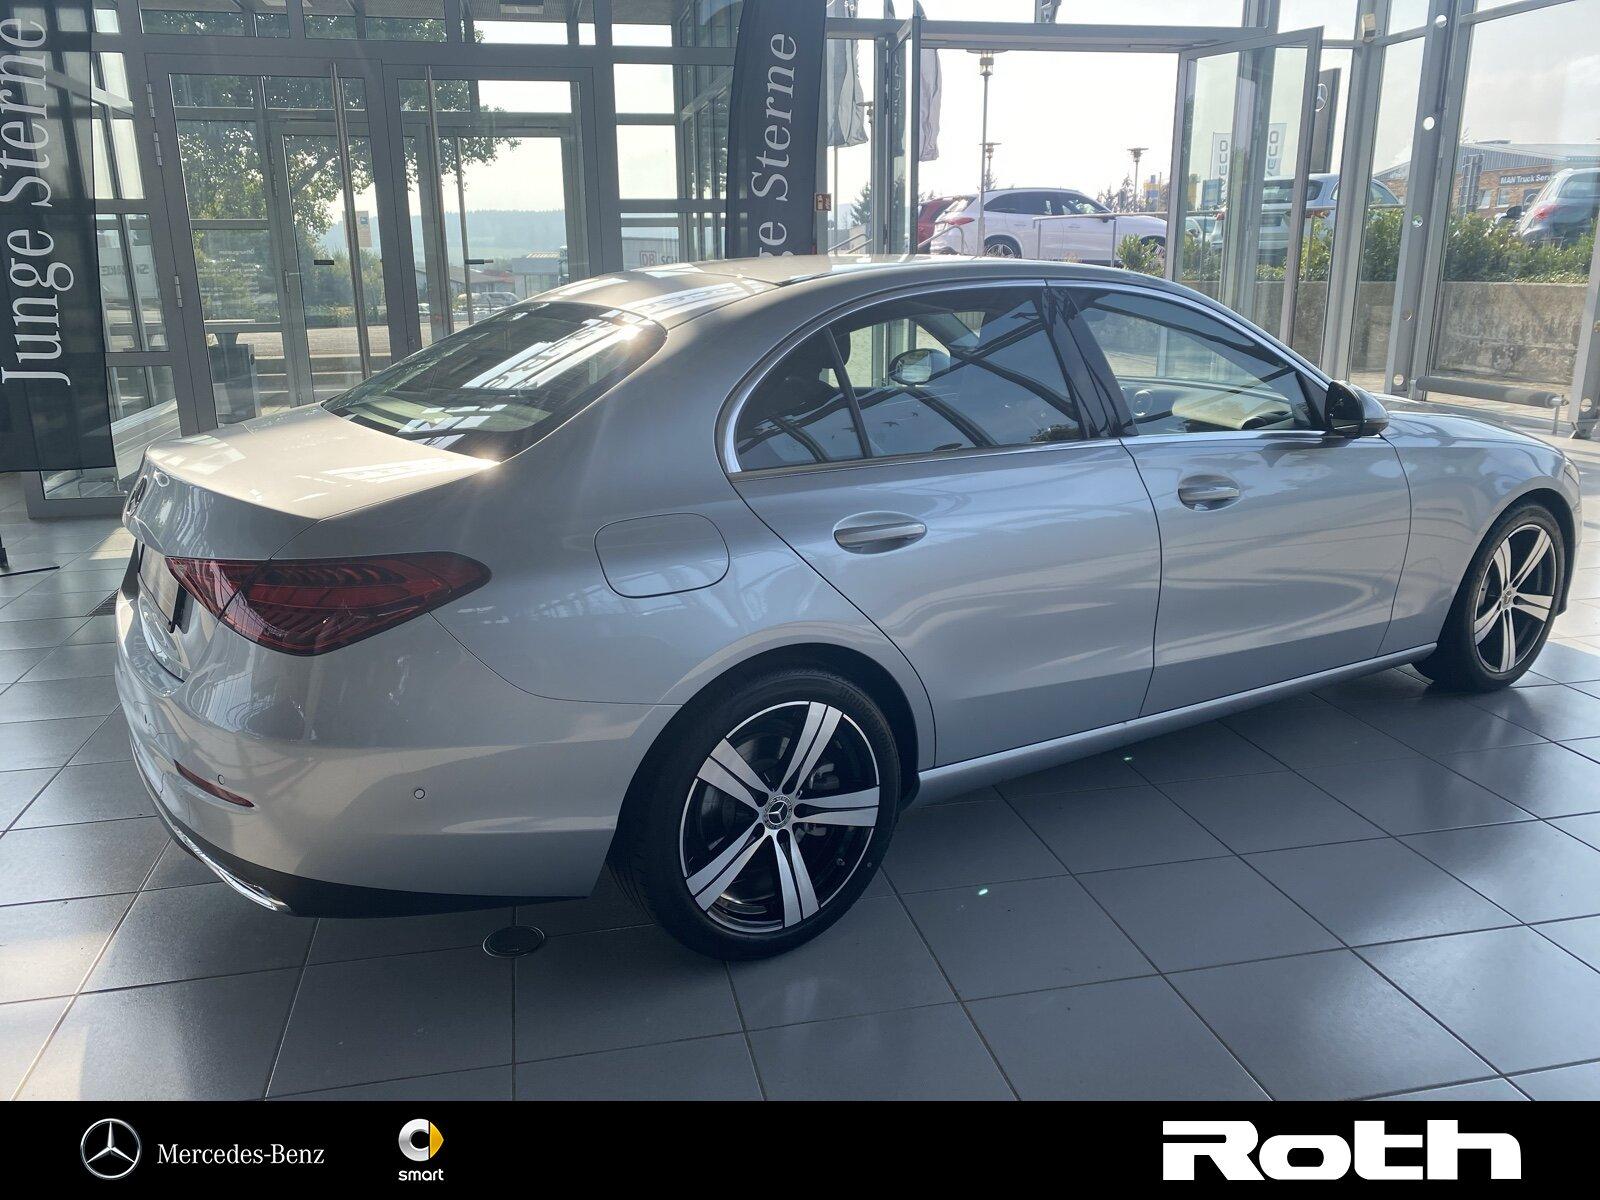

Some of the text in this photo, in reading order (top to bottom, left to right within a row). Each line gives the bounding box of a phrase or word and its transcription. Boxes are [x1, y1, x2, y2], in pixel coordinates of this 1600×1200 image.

[0, 17, 74, 387] Junge Sterne
[751, 32, 797, 202] Sterne
[1517, 174, 1536, 184] Truck
